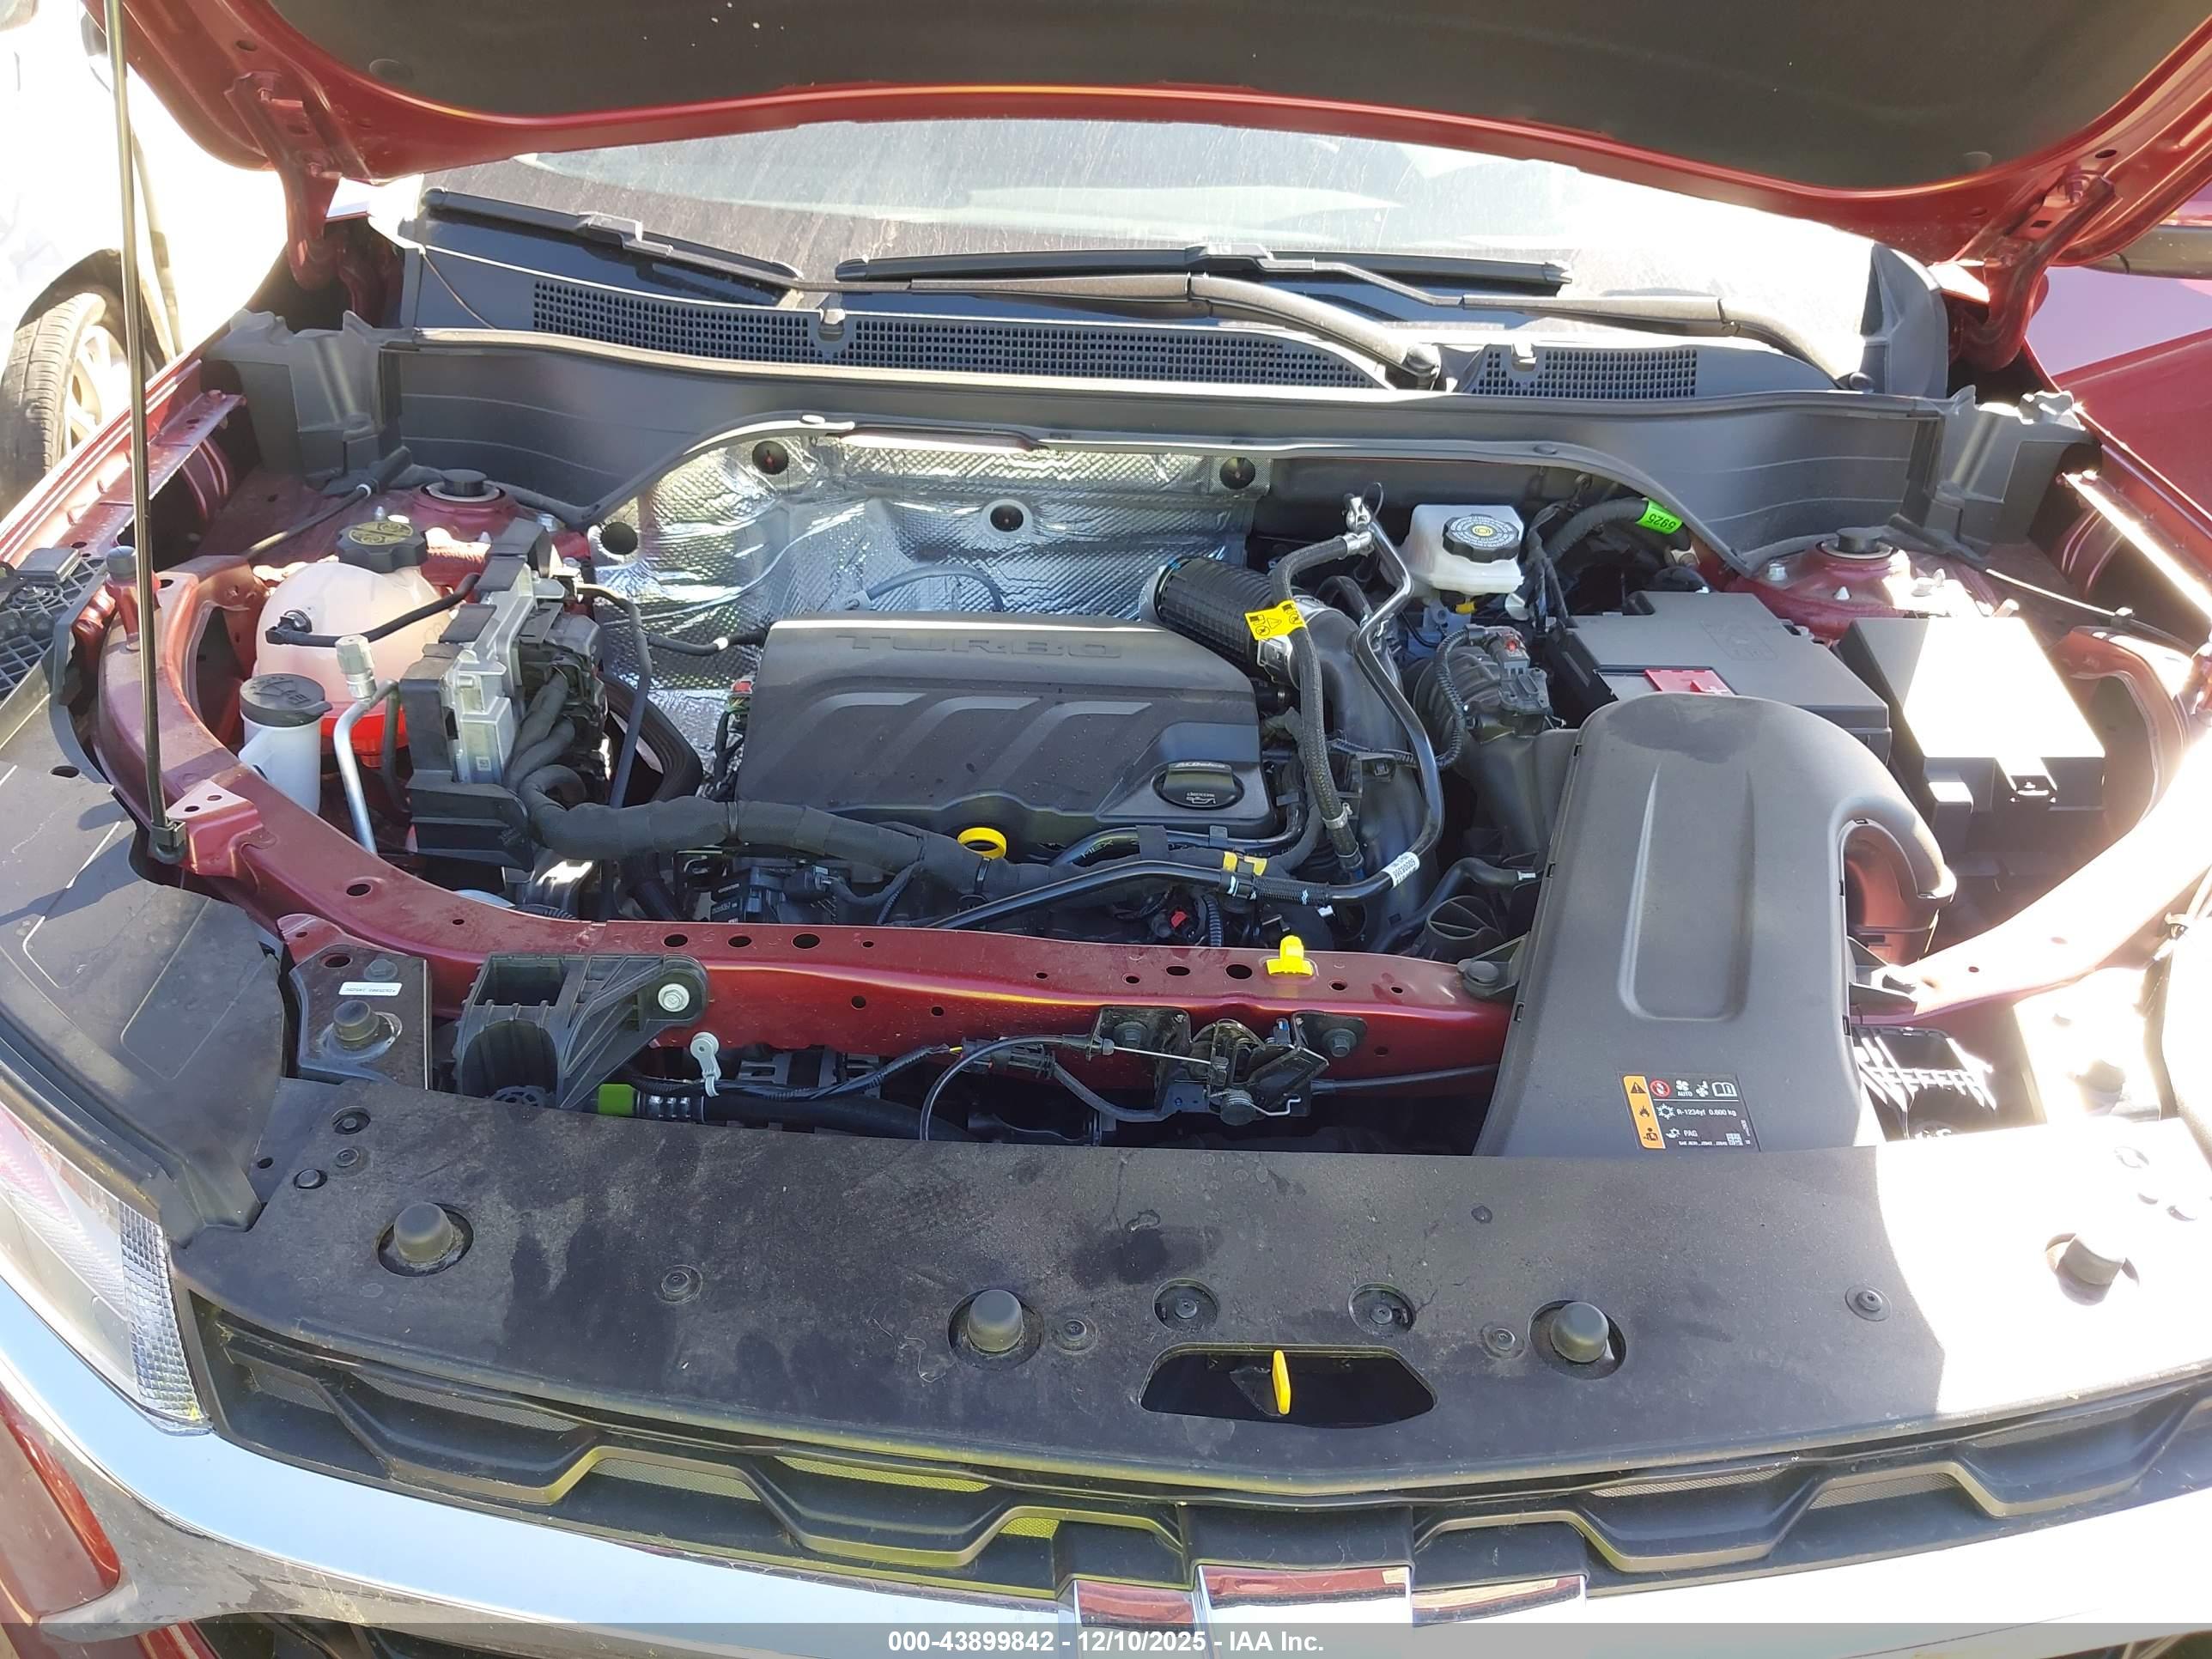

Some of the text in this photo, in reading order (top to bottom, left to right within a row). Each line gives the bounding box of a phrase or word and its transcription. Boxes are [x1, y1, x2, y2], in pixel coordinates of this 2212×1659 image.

[1646, 514, 1677, 530] 5925
[835, 635, 1121, 659] TURBO
[1727, 1109, 1736, 1117] kg
